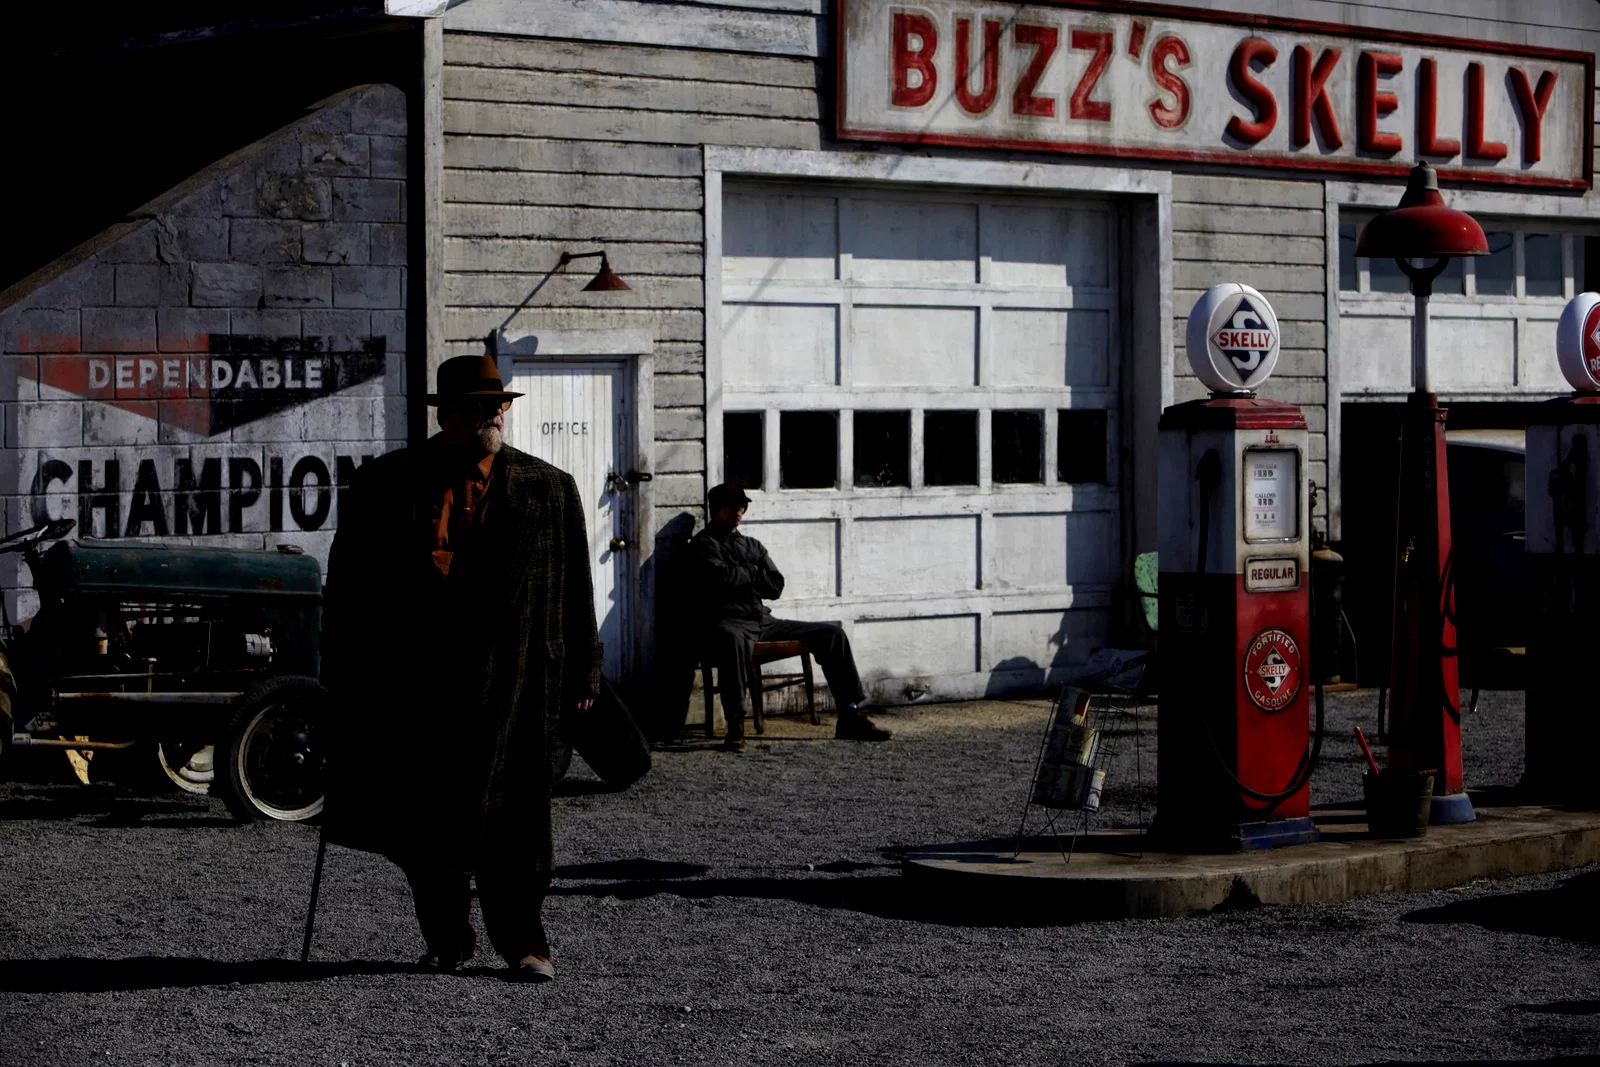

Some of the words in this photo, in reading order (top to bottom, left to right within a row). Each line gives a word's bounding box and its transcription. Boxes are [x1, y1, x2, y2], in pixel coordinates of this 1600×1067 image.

[891, 12, 1191, 129] BUZZ'S
[1226, 37, 1558, 163] SKELLY
[1219, 332, 1270, 347] SKELLY
[88, 357, 323, 389] DEPENDABLE
[542, 422, 588, 435] OFFICE
[1251, 568, 1294, 580] REGULAR
[1252, 634, 1295, 656] FORTIFIED
[1261, 665, 1287, 676] SKELLY
[1254, 688, 1292, 707] GASOLINE
